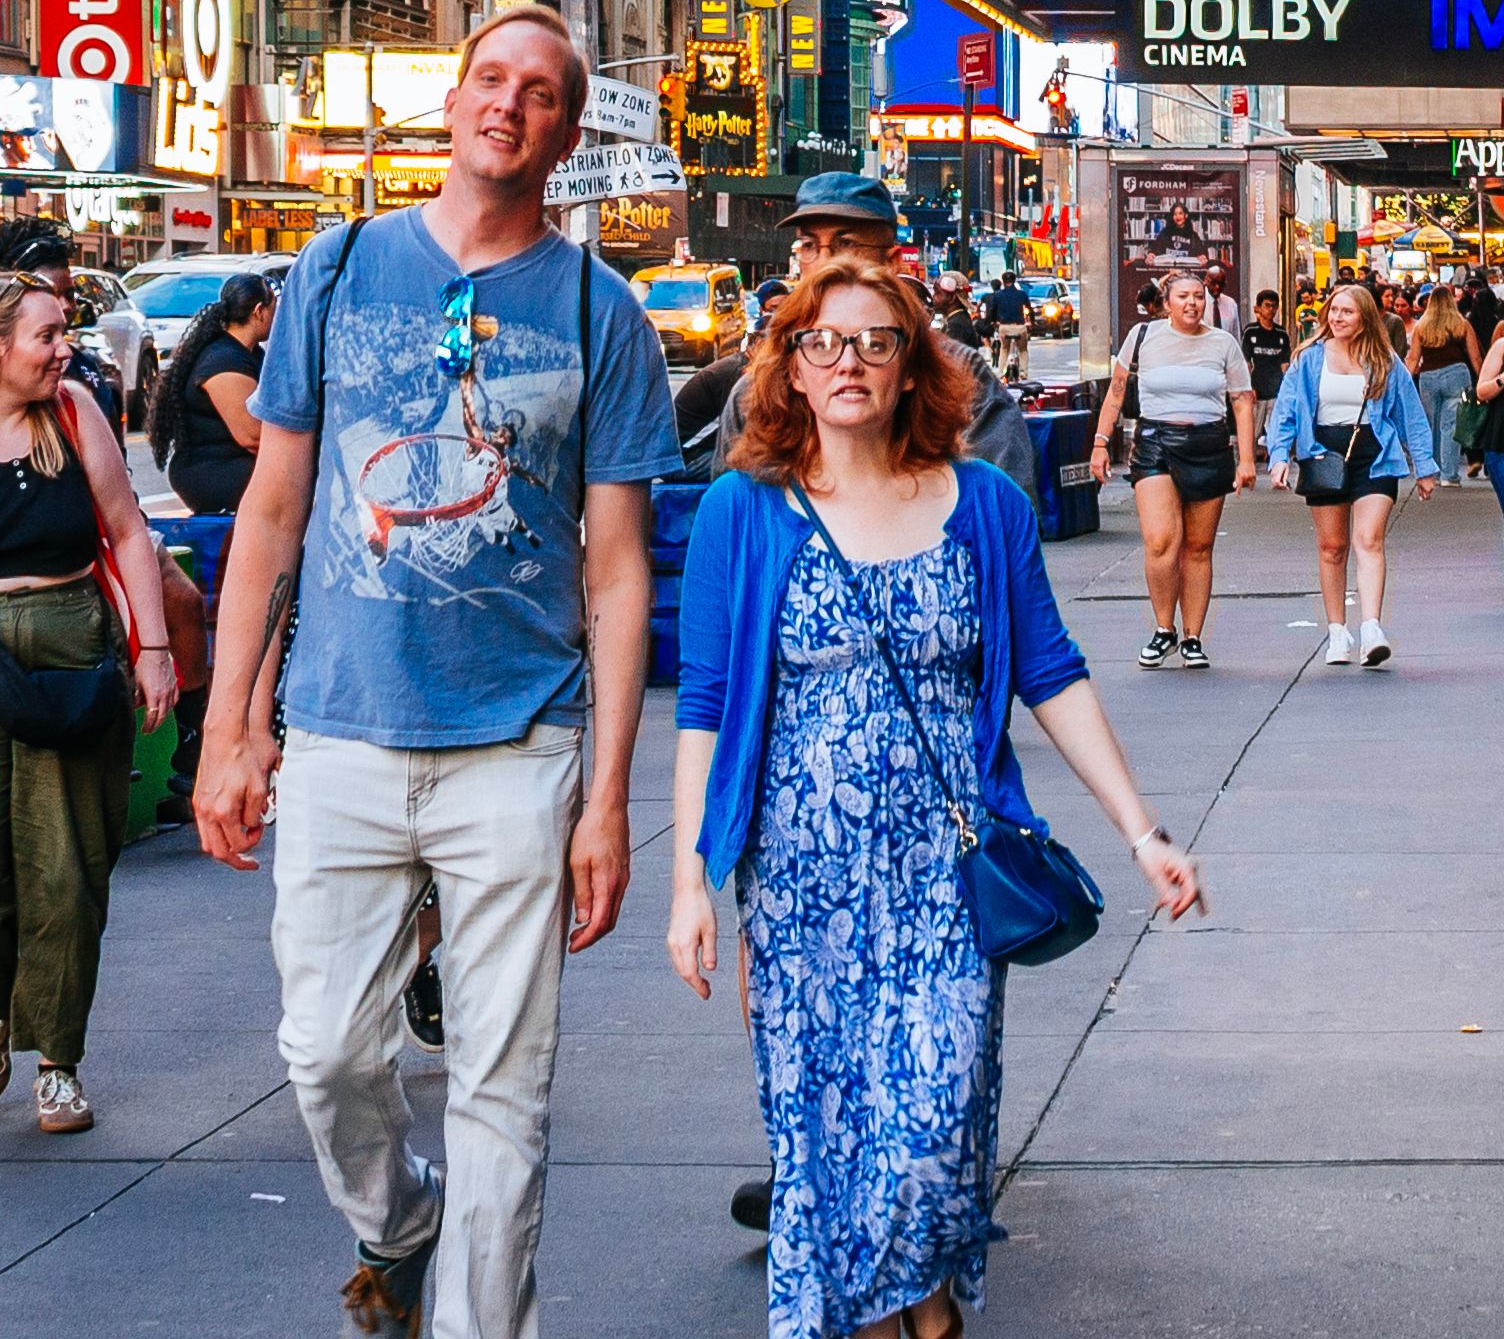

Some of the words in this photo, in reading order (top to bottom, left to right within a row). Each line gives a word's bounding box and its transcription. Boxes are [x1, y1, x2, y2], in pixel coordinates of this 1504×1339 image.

[1143, 43, 1247, 69] CINEMA
[621, 93, 654, 116] ZONE
[717, 110, 753, 138] Potter
[568, 174, 613, 197] MOVING
[1139, 180, 1187, 190] FORDHAM
[617, 197, 671, 235] Potter
